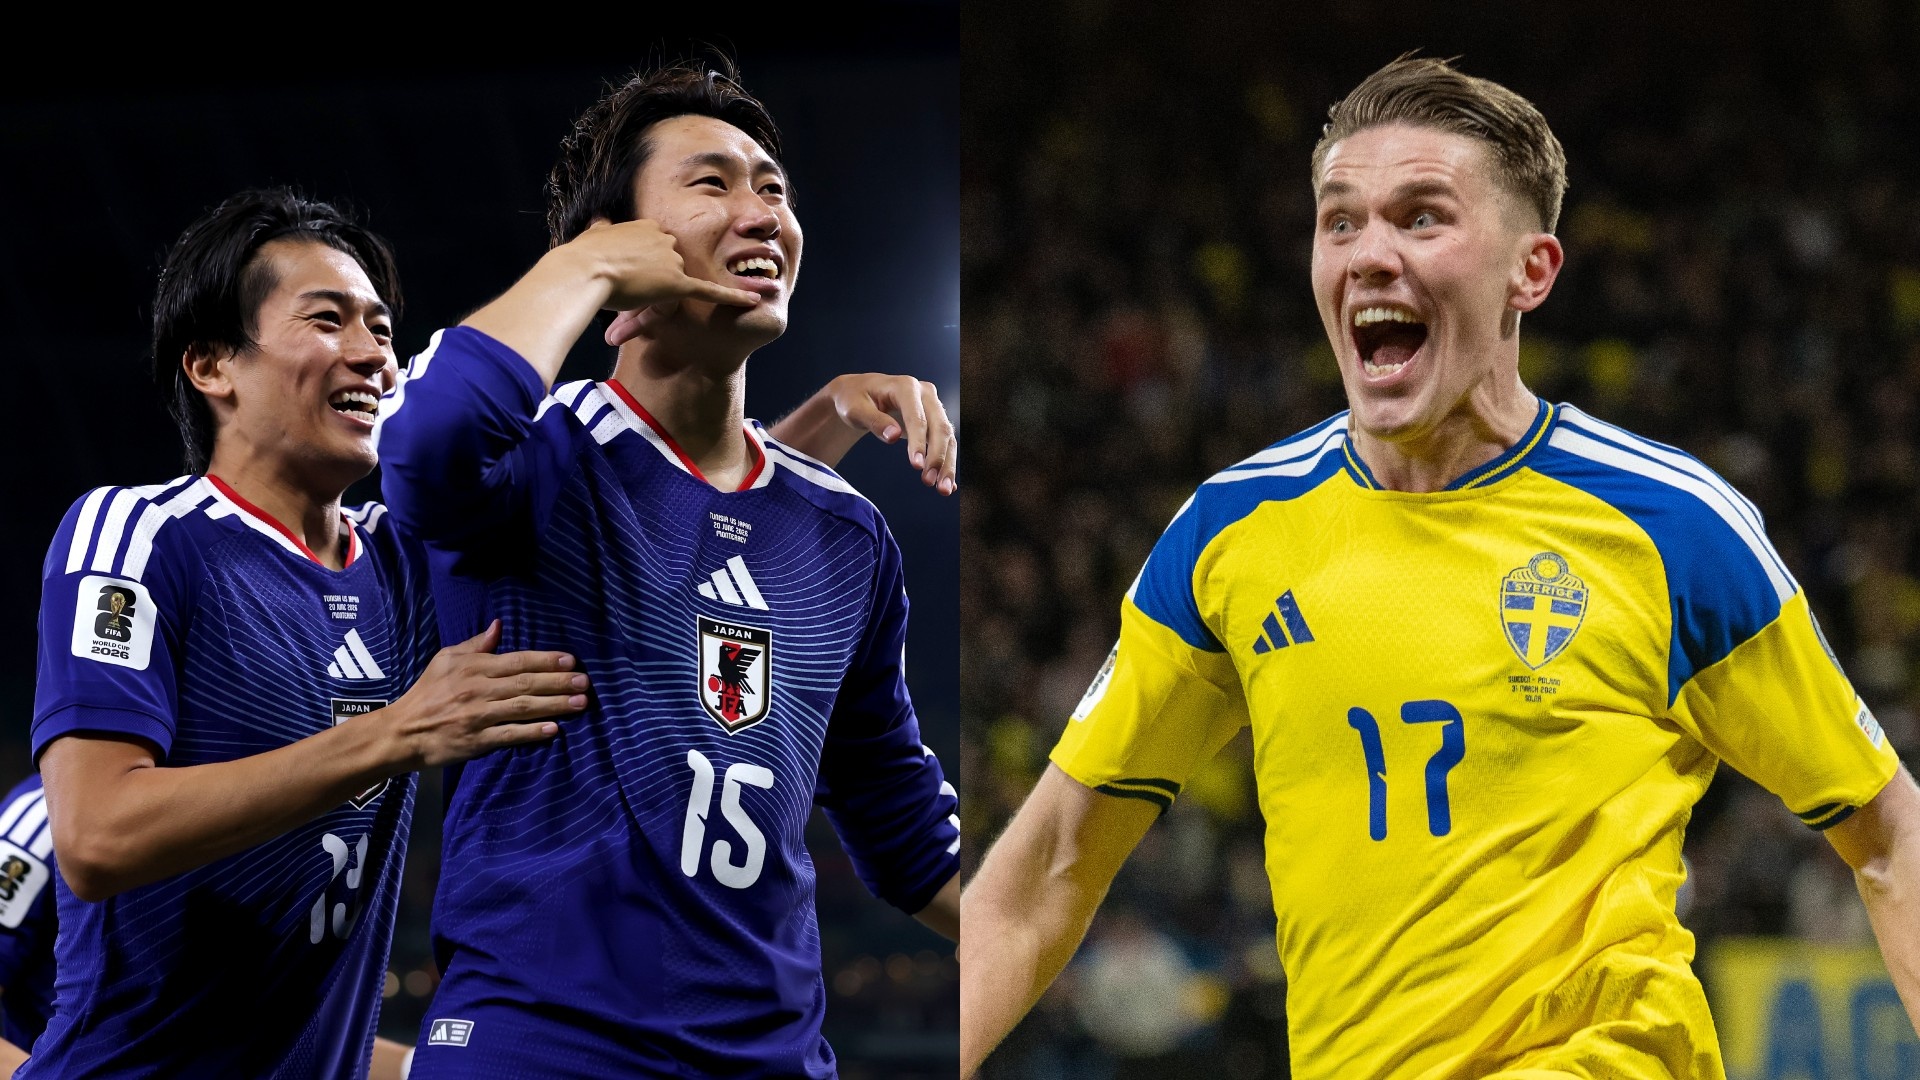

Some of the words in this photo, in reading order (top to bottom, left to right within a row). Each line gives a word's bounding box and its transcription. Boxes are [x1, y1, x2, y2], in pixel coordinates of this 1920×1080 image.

[709, 512, 728, 523] TUNISIA
[722, 524, 734, 532] JUNE
[1514, 581, 1574, 600] SVERIGE
[328, 603, 336, 611] 20
[104, 627, 122, 638] FIFA
[713, 624, 752, 640] JAPAN
[92, 640, 117, 649] WORLD
[91, 646, 129, 660] 2026
[1540, 686, 1557, 695] 2026
[341, 703, 370, 713] JAPAN
[714, 694, 748, 717] JFA
[1347, 699, 1466, 842] 17
[680, 748, 775, 889] 15
